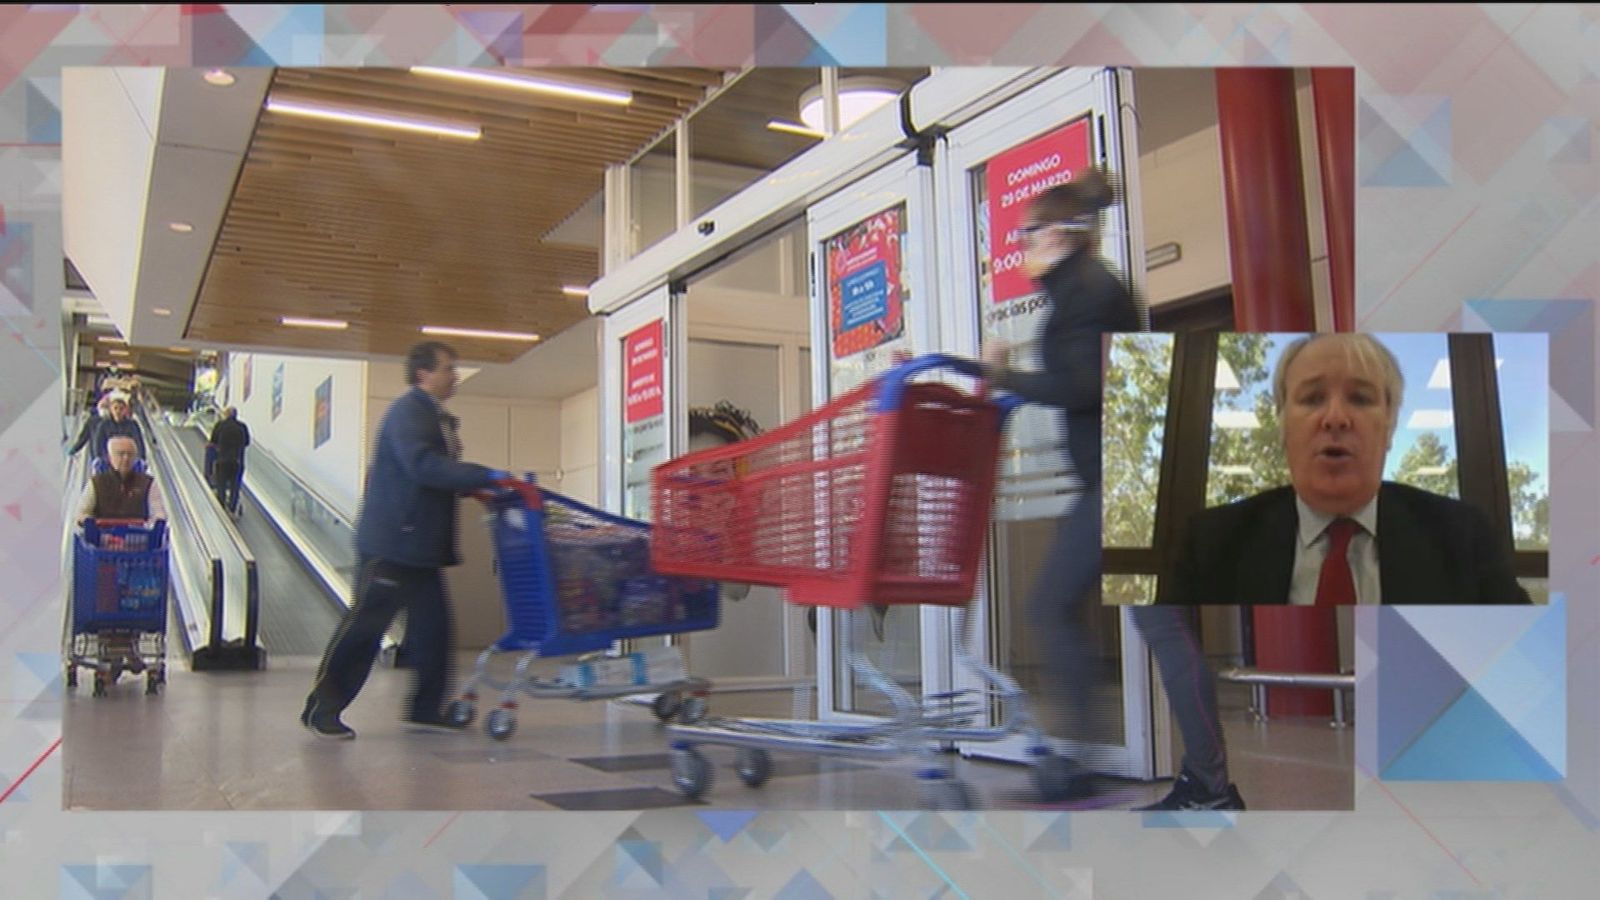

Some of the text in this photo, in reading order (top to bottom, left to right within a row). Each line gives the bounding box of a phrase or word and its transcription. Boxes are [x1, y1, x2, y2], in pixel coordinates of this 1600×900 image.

[1007, 153, 1061, 186] DOMINGO
[1015, 185, 1030, 203] DE
[1031, 169, 1072, 195] MARZO
